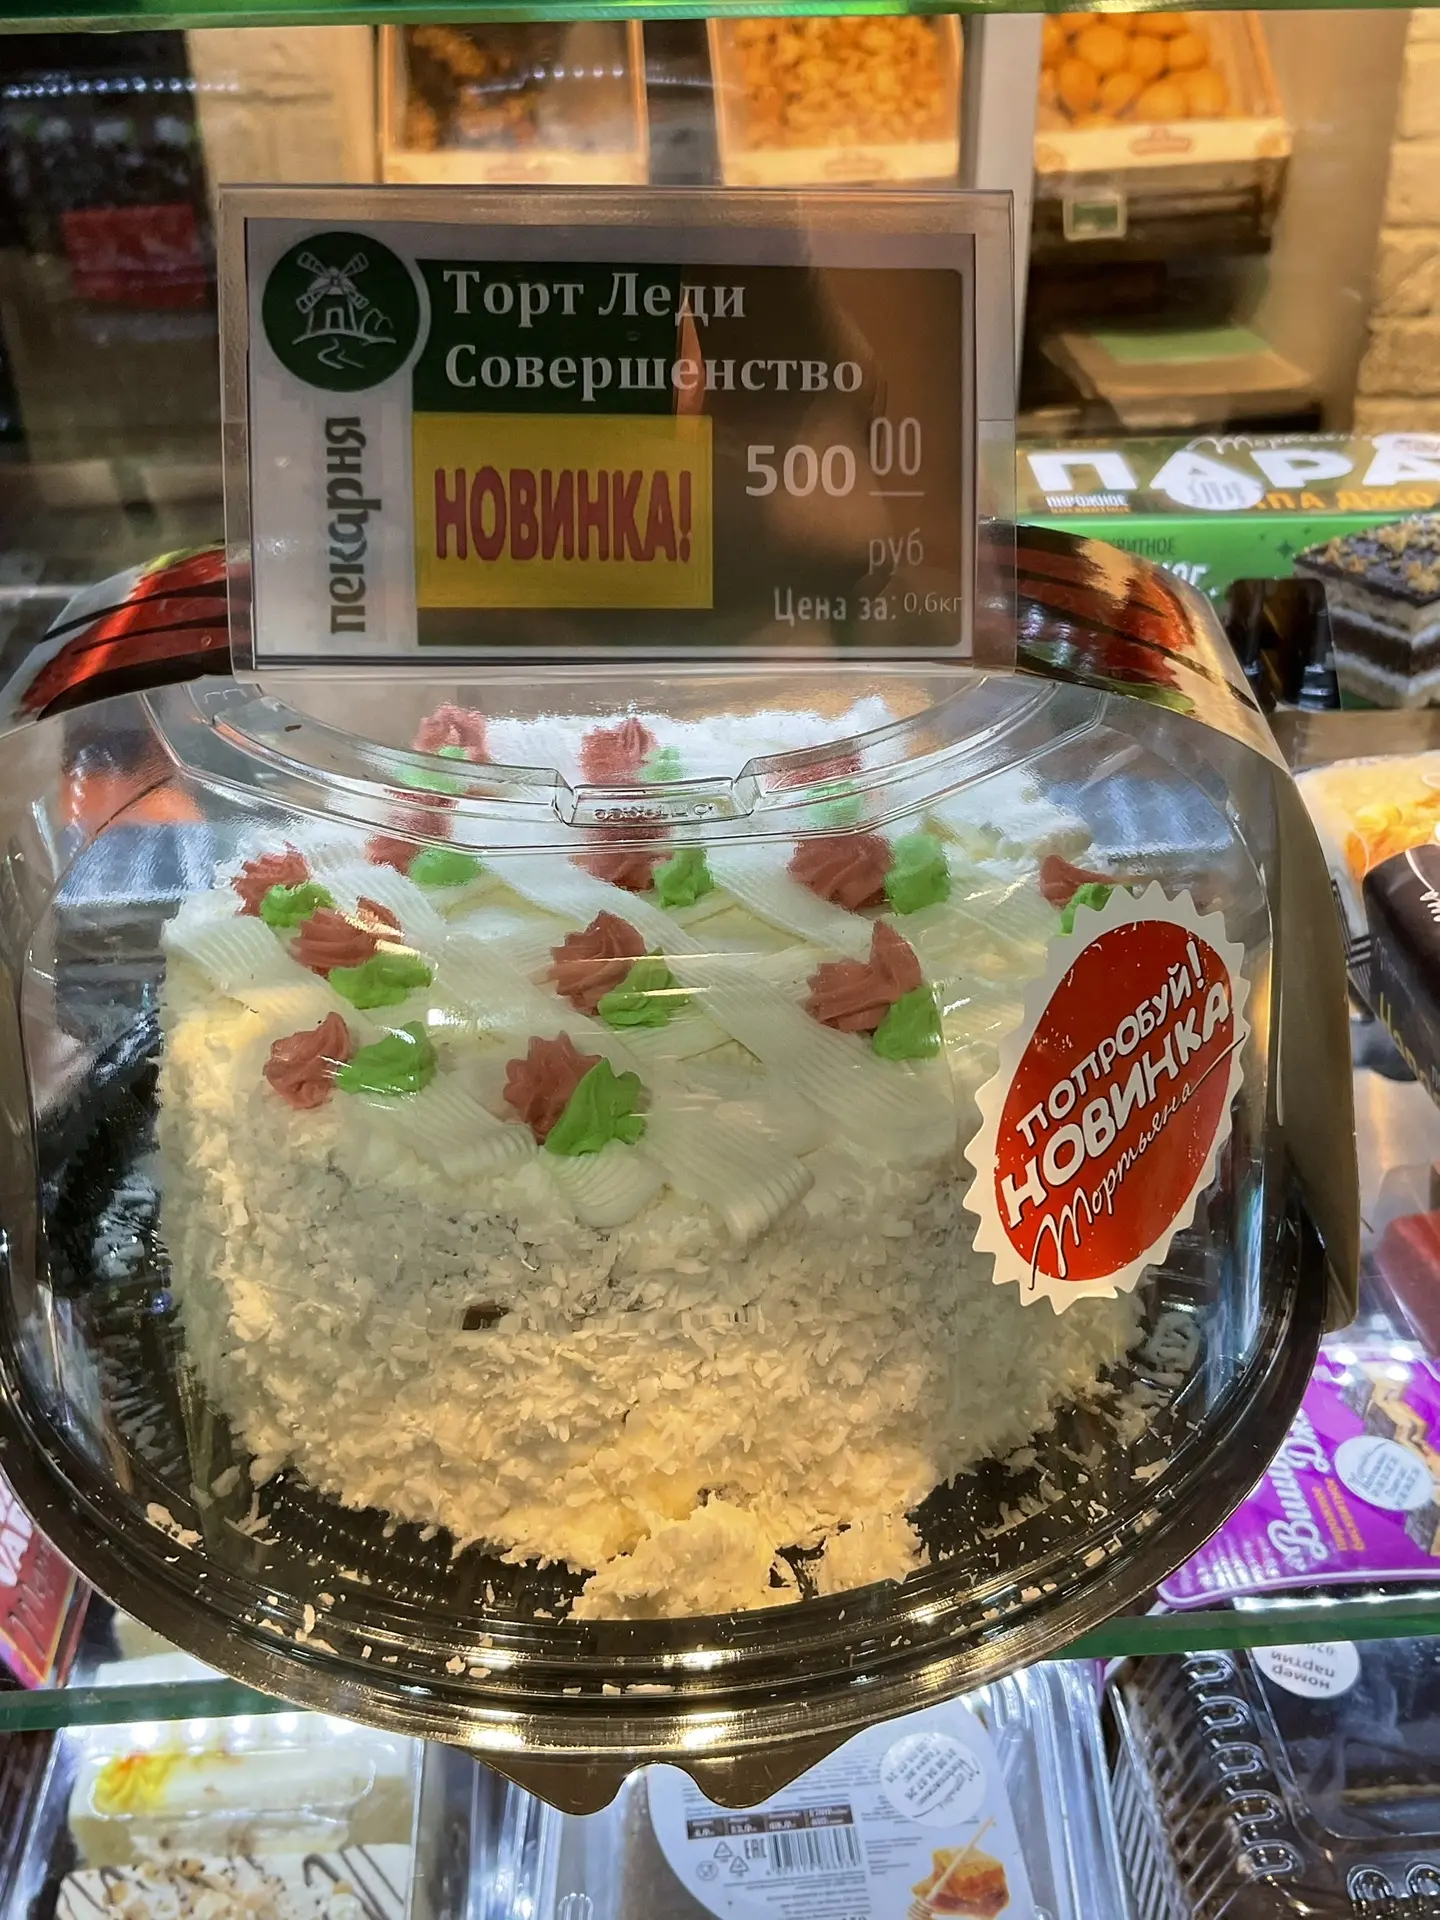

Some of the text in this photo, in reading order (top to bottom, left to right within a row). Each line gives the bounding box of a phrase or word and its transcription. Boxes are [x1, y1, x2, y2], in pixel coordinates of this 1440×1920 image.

[443, 270, 746, 328] Торт Леди
[445, 344, 864, 401] Совершенство
[746, 416, 922, 497] 500 00
[324, 416, 382, 635] пекарня
[434, 465, 692, 562] НОВИНКА!
[869, 528, 924, 575] руб
[773, 586, 963, 627] Цена за: 0,6кг
[1015, 939, 1206, 1148] ПОПРОБУЙ!
[1001, 981, 1231, 1230] НОВИНКА
[1028, 1040, 1240, 1291] Мортьяна
[1270, 1651, 1335, 1678] партии
[1272, 1664, 1331, 1689] номер
